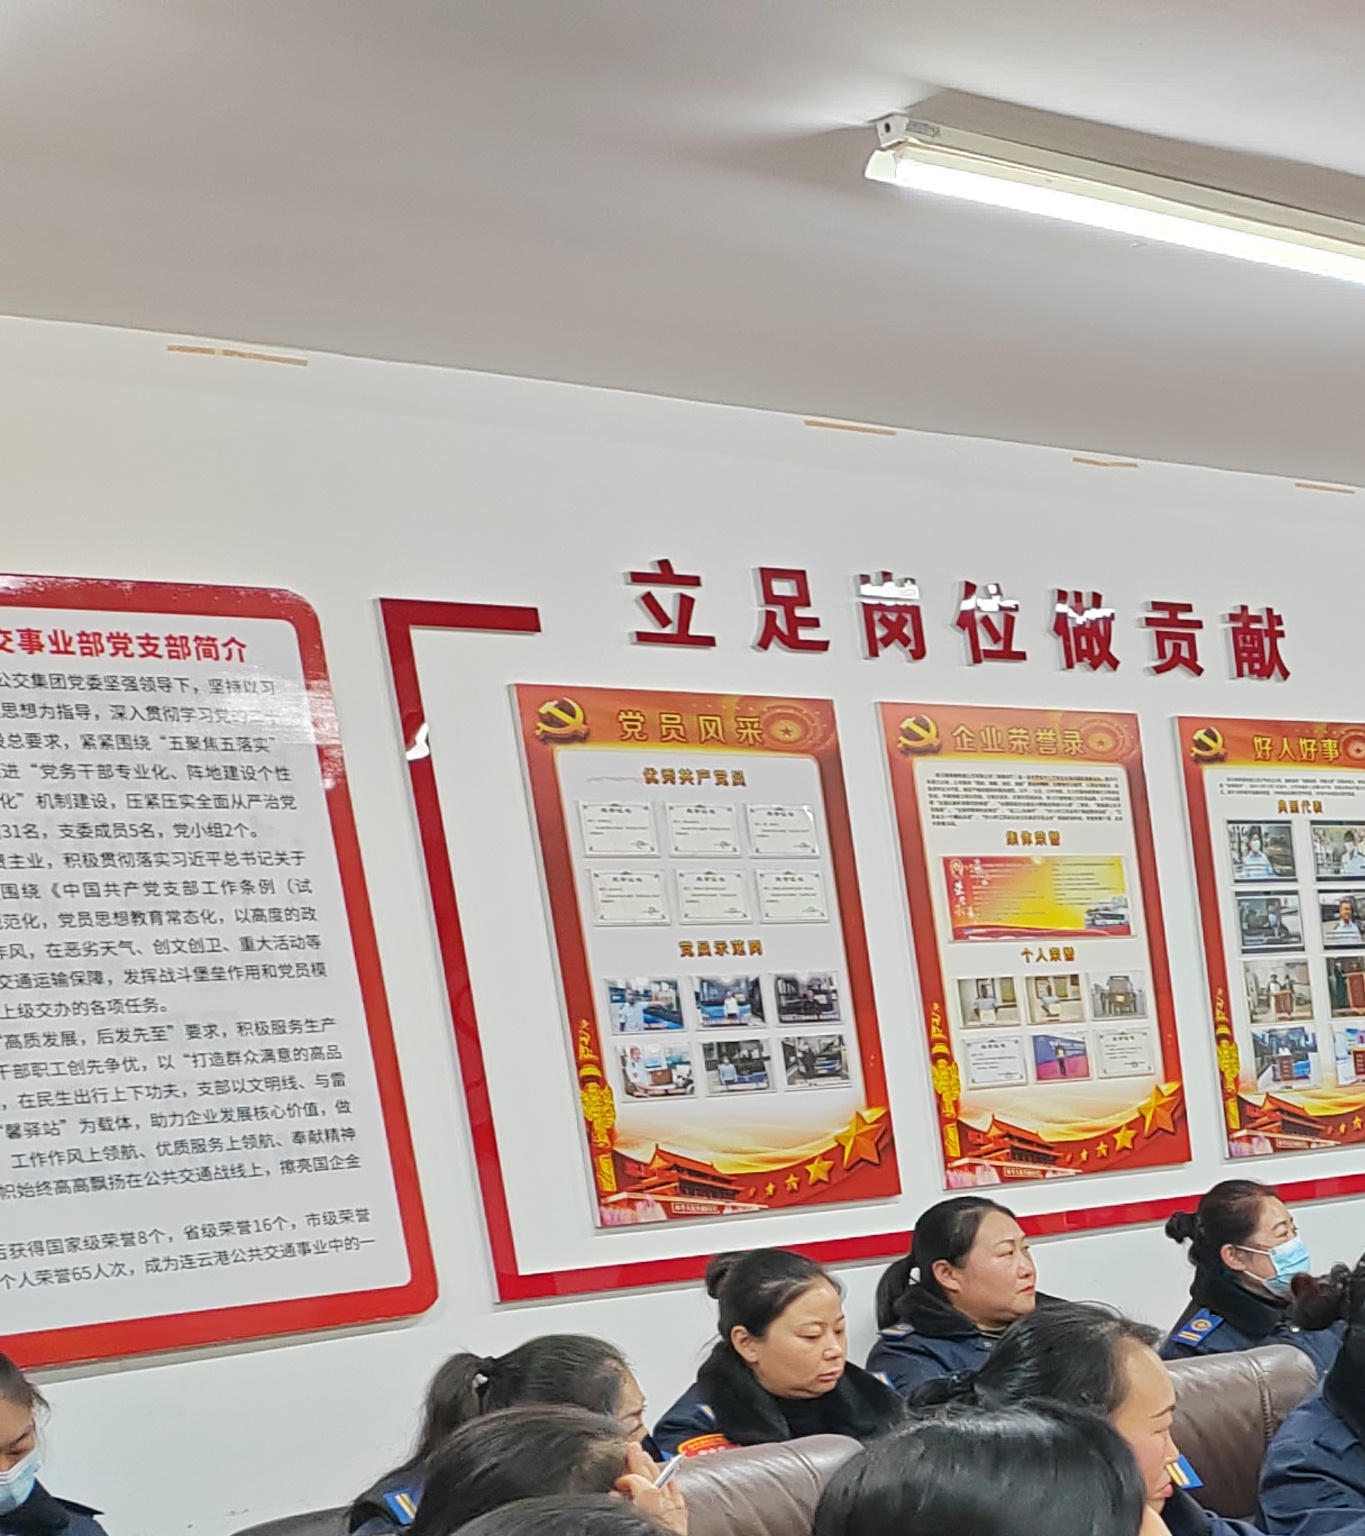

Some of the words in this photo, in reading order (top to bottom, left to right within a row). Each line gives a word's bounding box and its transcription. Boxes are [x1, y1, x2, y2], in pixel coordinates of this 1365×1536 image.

[624, 558, 1291, 681] 立足岗位做贡献
[616, 710, 766, 746] 党员风采
[951, 722, 1085, 756] 企业荣誉录
[0, 732, 276, 753] 总要求，紧紧围绕“五聚焦五落实”
[1252, 735, 1341, 762] 好人好事
[0, 763, 293, 782] 进“党务干部专业化、阵地建设个性
[642, 766, 748, 788] 优秀共产党员
[0, 822, 258, 840] 31名，支委成员5名，党小组2个。
[1005, 830, 1061, 847] 集体荣誉
[0, 906, 318, 931] 范化，党员思想教育常态化，以高度的政
[678, 939, 764, 958] 党员示范岗
[1020, 946, 1076, 964] 个人荣誉
[0, 997, 168, 1020] 上级交办的各项任务。
